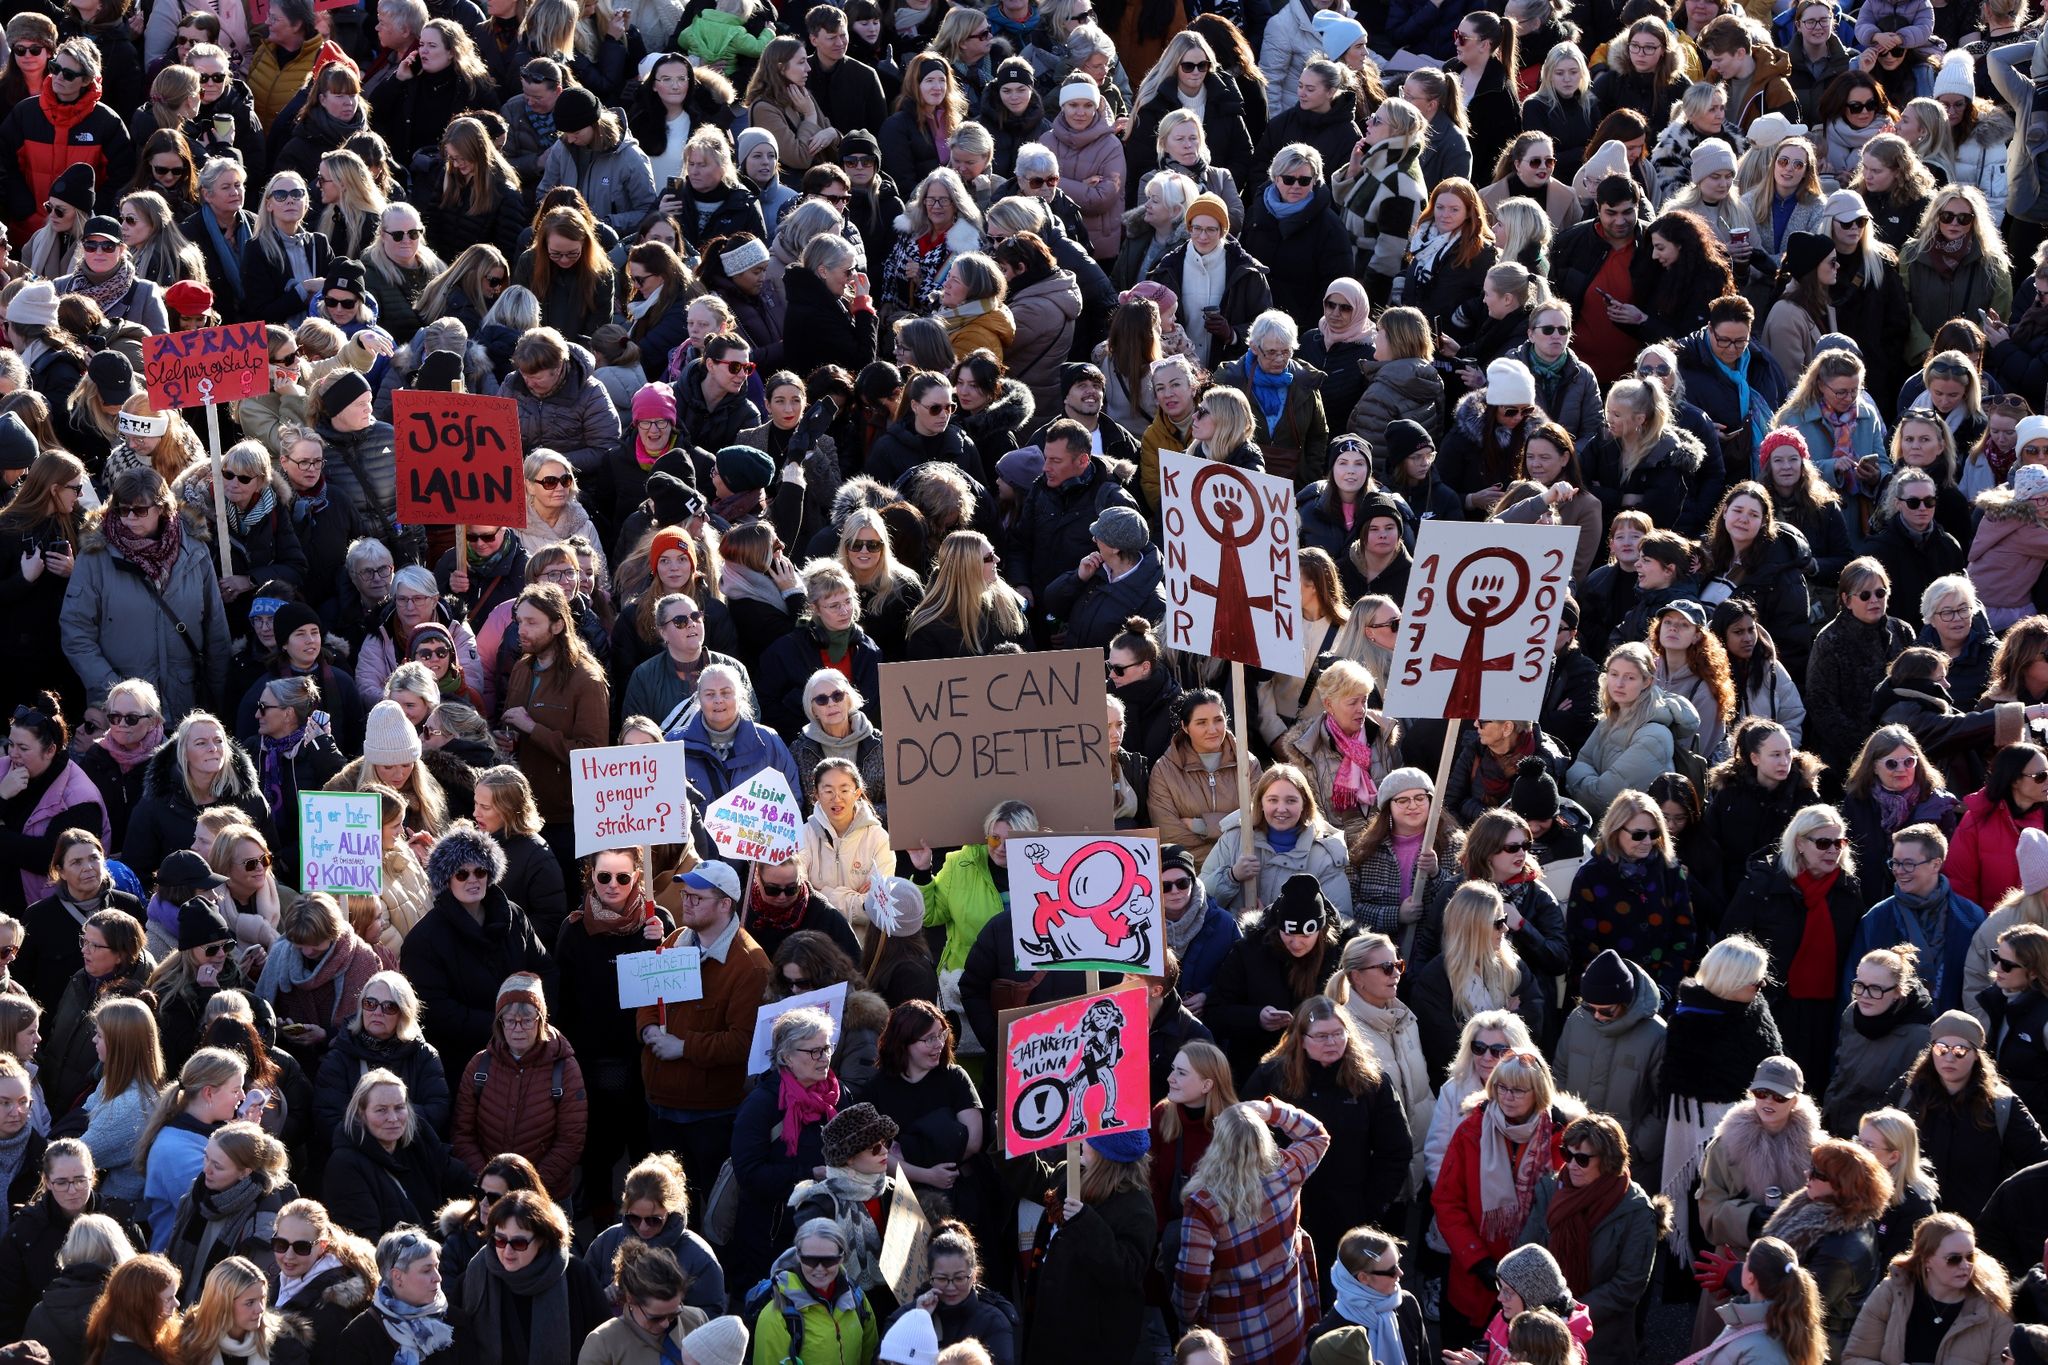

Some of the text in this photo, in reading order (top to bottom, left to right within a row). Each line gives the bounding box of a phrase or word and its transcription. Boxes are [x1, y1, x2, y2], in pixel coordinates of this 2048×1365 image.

[410, 465, 513, 514] LAUN
[1163, 466, 1194, 646] KONUR
[1262, 485, 1294, 641] WOMEN
[1401, 554, 1440, 687] 1975
[1518, 549, 1564, 683] 2023
[902, 661, 1081, 723] WE CAN
[581, 755, 658, 783] Hvernig
[896, 723, 1105, 786] DO BETTER
[305, 797, 373, 834] Ég er hér
[595, 785, 655, 813] gengur
[730, 794, 757, 812] ERU
[759, 803, 779, 823] 48
[595, 802, 672, 838] strákar?
[338, 831, 381, 860] ALLAR
[321, 863, 379, 894] KONUR
[1023, 1055, 1067, 1081] NÚNA
